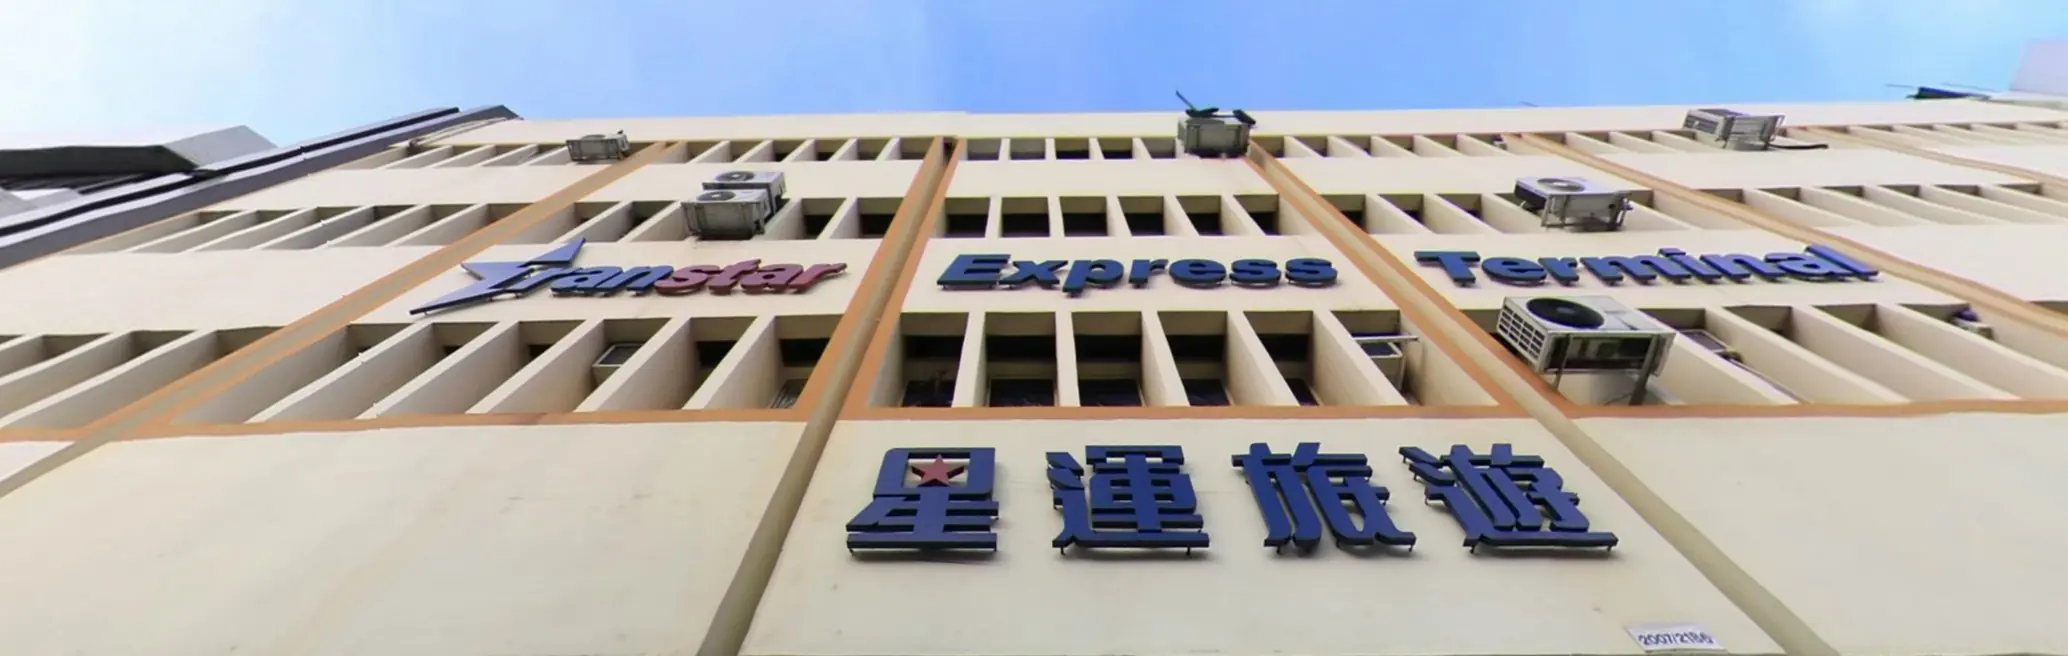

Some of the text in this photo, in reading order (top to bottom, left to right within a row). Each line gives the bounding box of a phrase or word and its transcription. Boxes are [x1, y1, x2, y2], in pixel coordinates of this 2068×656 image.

[410, 237, 1880, 315] Transtar Express Terminal
[846, 441, 1619, 555] 星運旅遊
